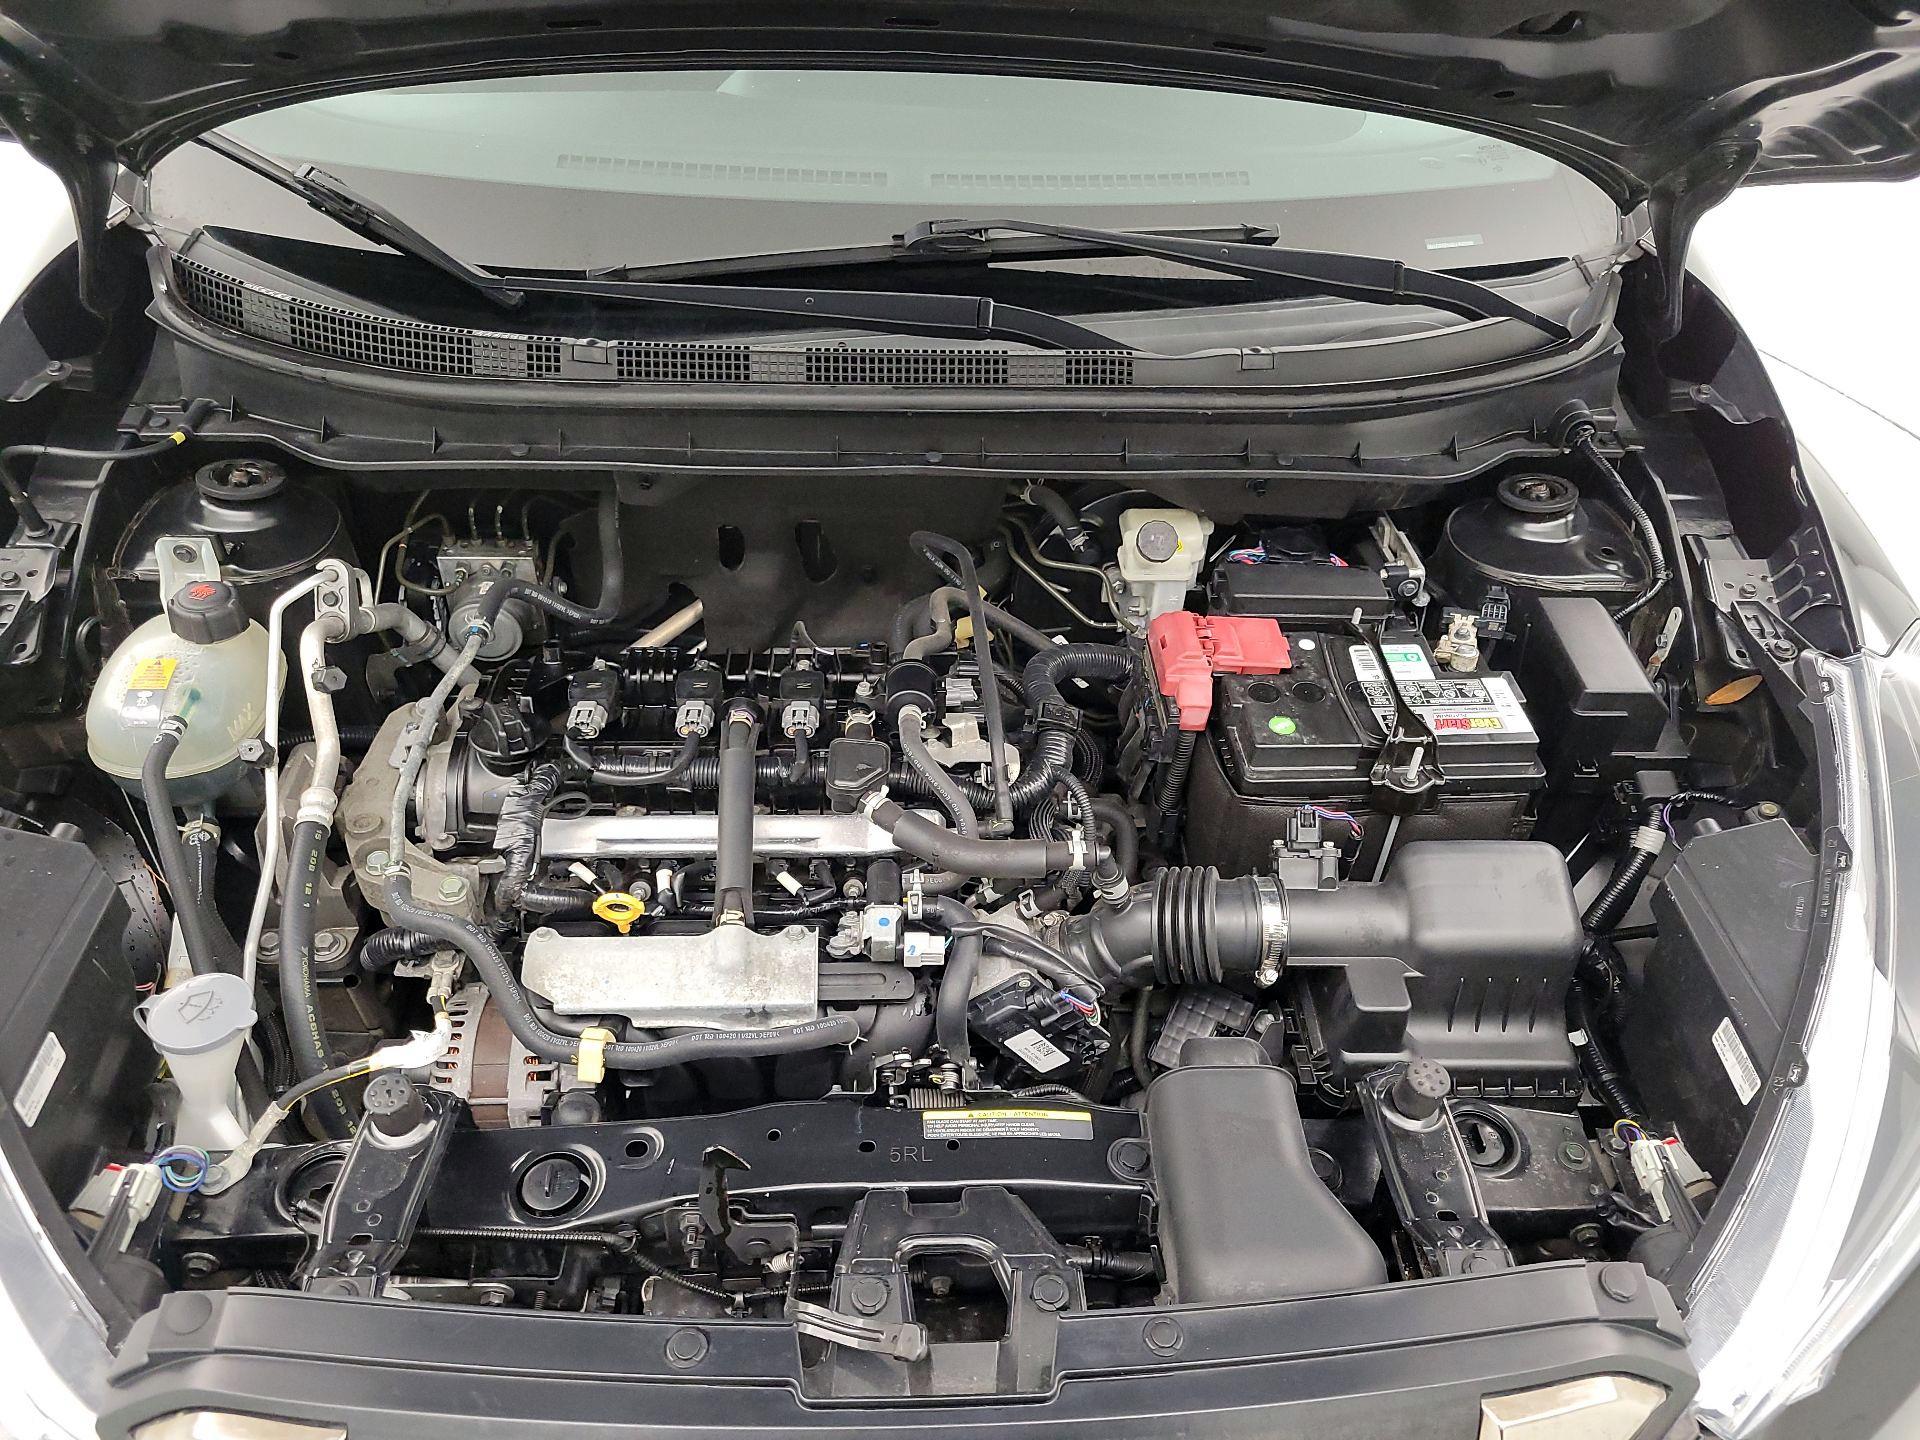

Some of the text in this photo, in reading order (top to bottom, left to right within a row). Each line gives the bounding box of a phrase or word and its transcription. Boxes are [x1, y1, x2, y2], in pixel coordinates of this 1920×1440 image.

[1434, 718, 1503, 731] EverStart
[301, 957, 312, 998] YOKOHAMA
[890, 1146, 933, 1163] 5RL
